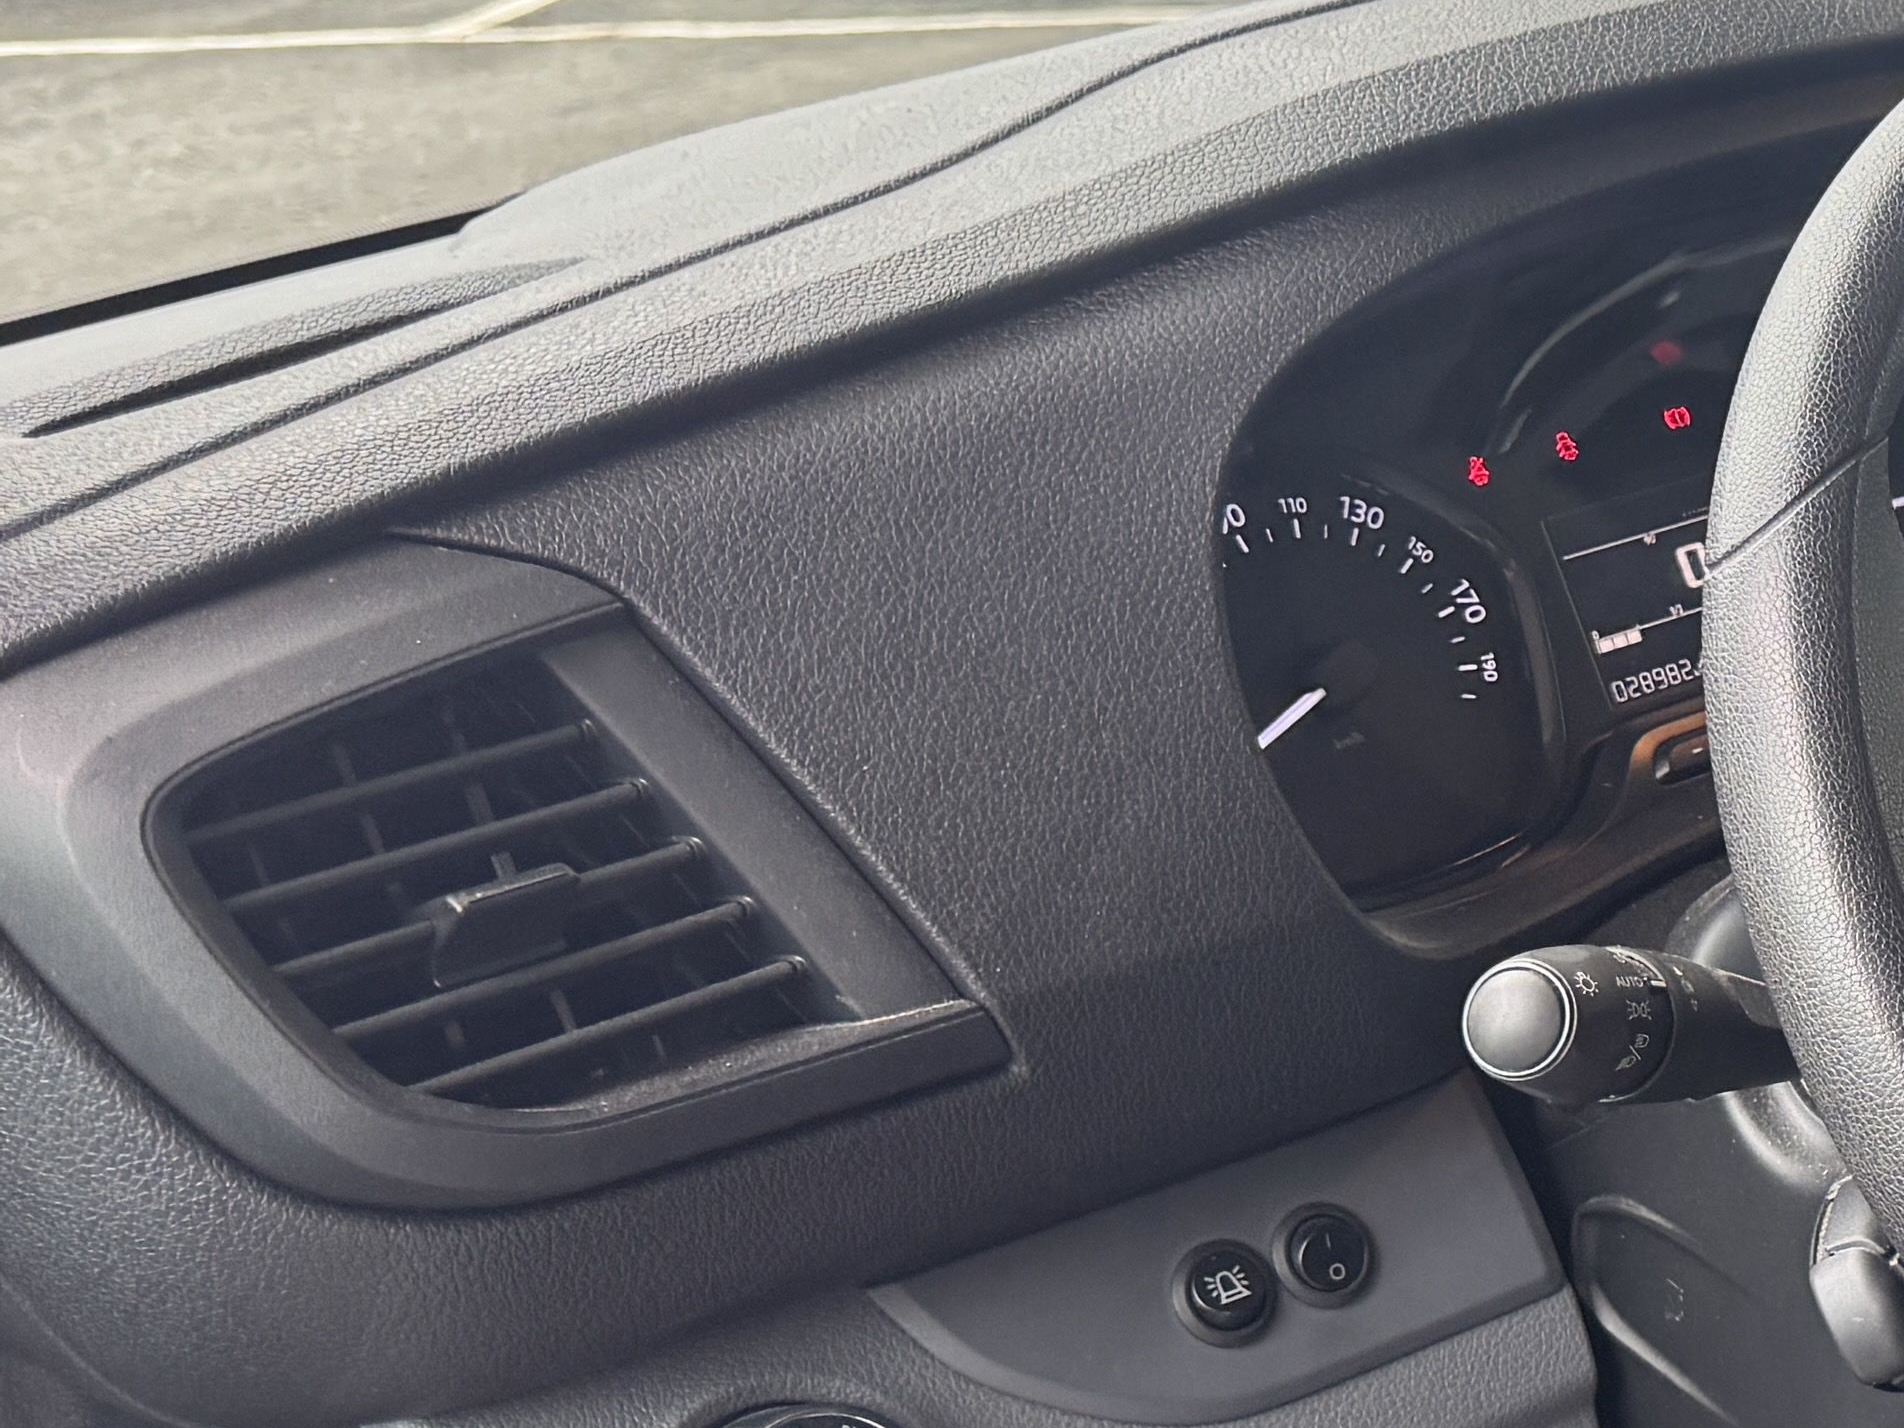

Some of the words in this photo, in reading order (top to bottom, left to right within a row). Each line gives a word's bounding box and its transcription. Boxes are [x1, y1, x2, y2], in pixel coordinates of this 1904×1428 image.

[1278, 497, 1308, 515] 110
[1338, 496, 1385, 530] 130
[1408, 536, 1434, 565] 150
[1450, 579, 1487, 624] 170
[1480, 652, 1498, 682] 190
